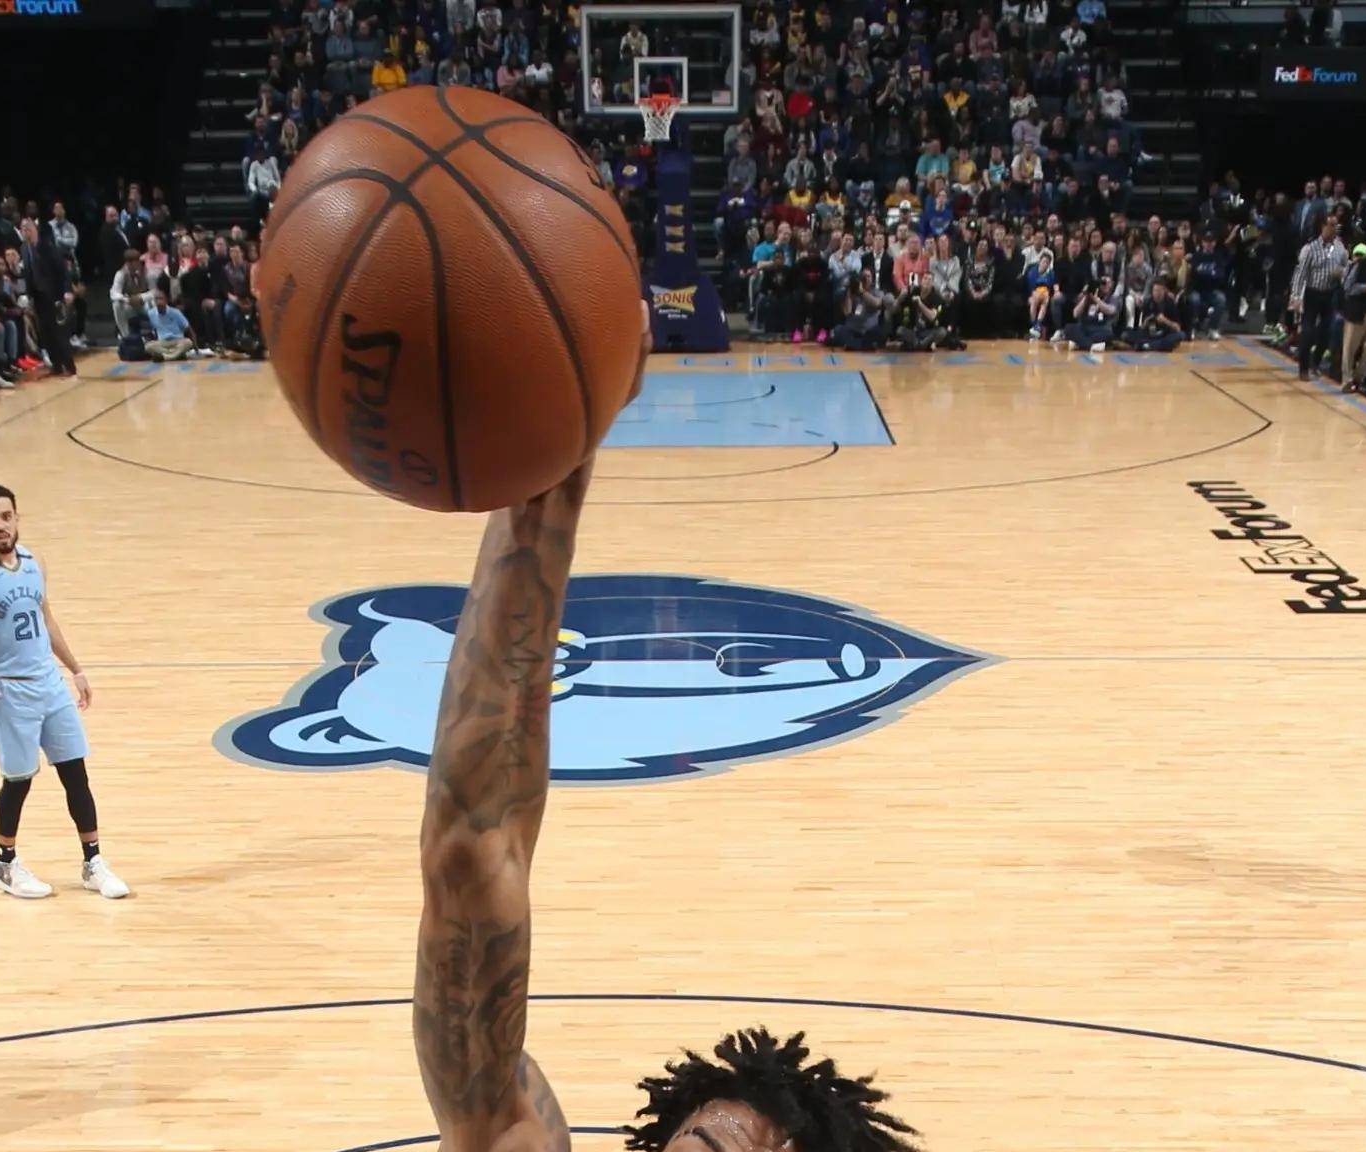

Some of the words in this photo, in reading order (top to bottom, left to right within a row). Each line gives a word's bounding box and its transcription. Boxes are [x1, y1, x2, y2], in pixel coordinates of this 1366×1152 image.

[1275, 66, 1357, 83] FedExForum
[654, 292, 694, 305] SONIC
[13, 610, 41, 642] 21
